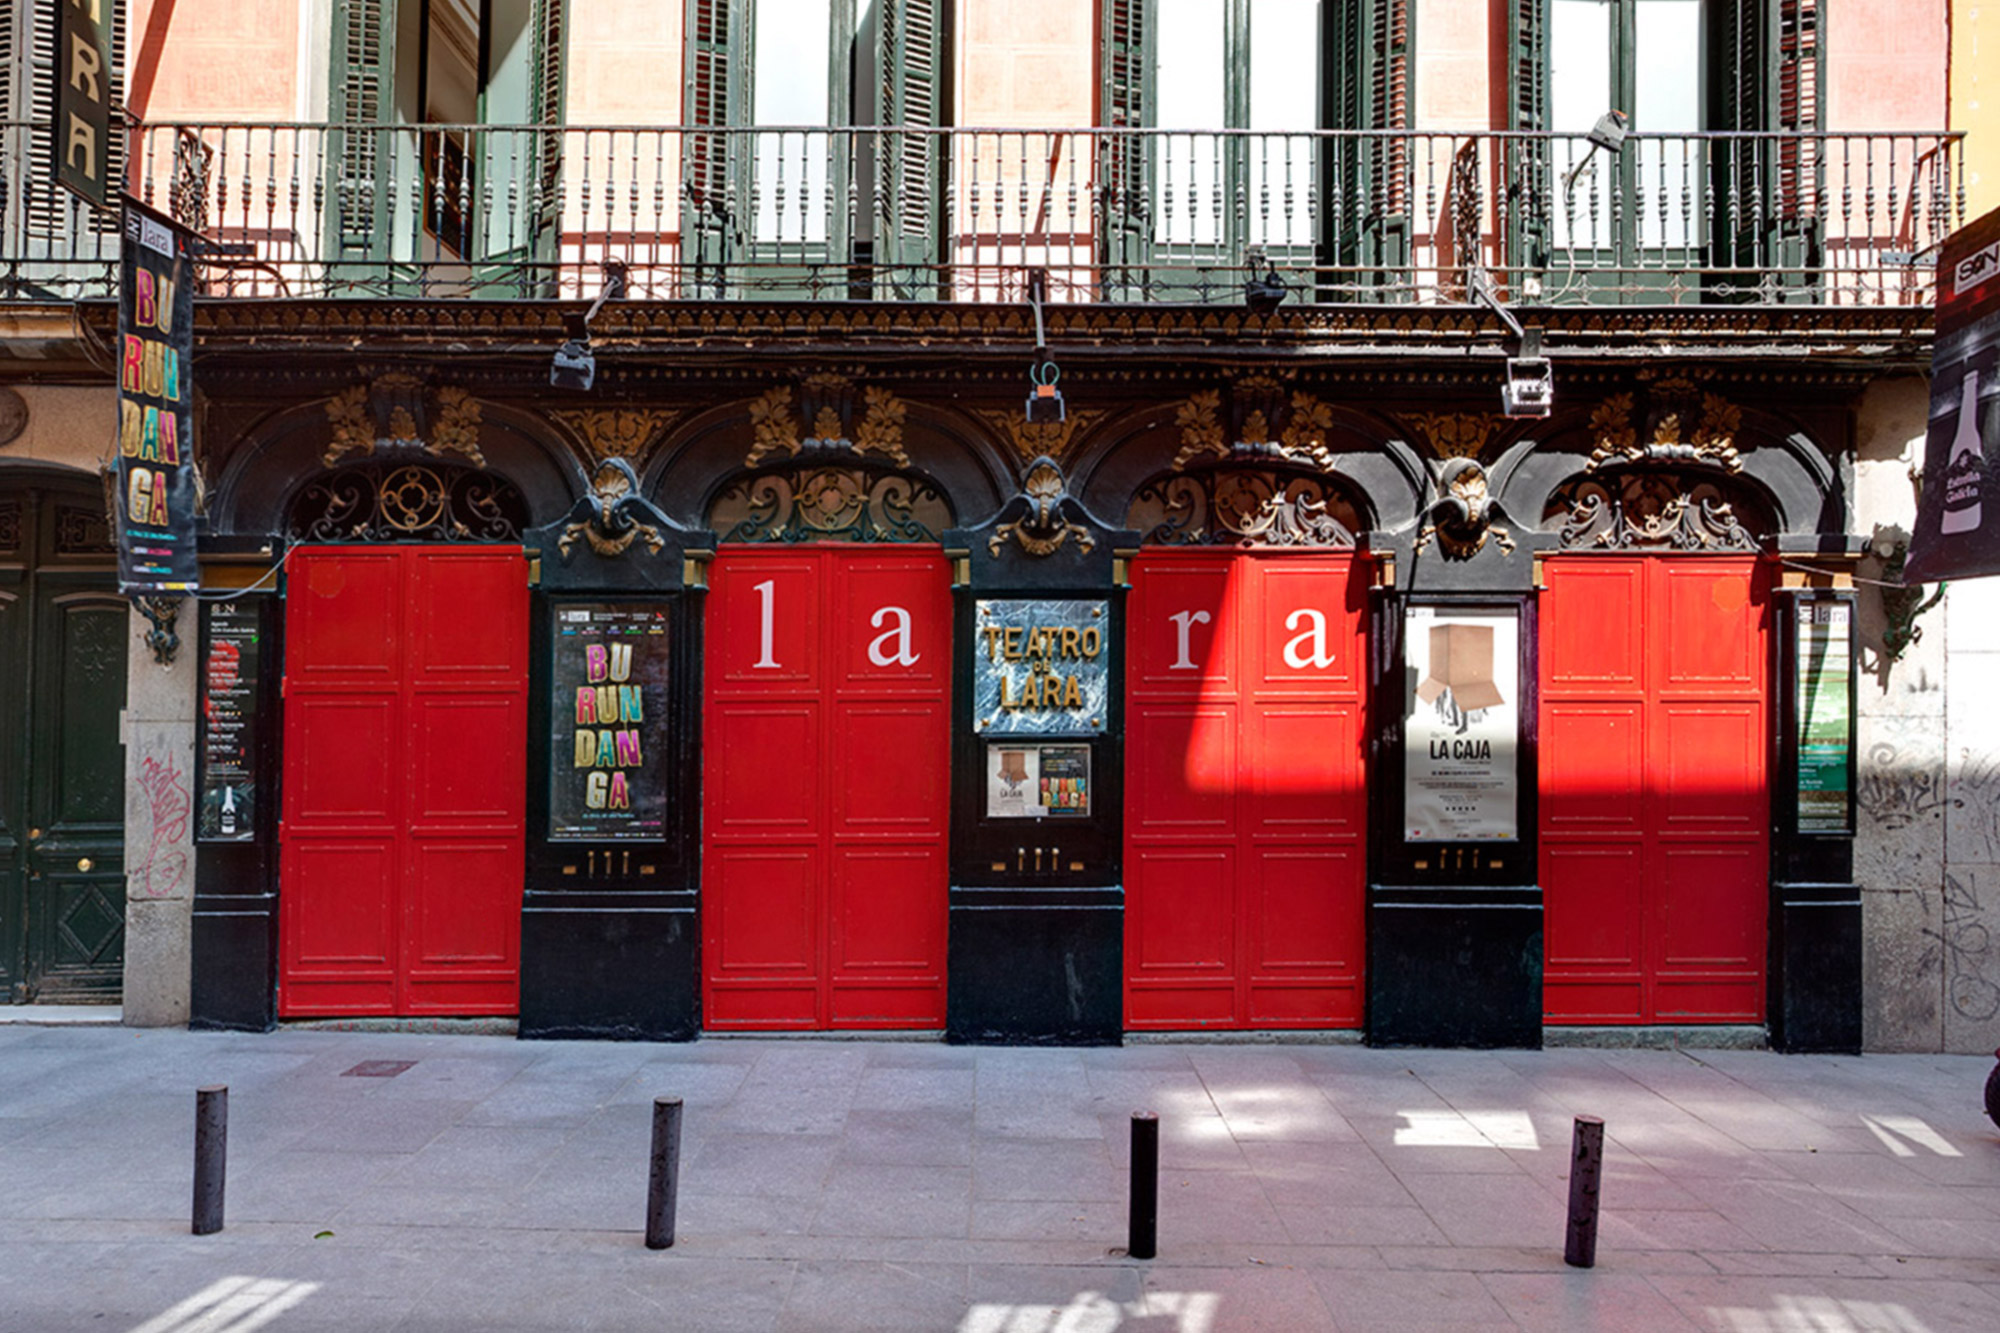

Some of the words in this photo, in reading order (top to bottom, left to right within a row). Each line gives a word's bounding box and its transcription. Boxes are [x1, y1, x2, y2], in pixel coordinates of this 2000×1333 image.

[67, 0, 101, 181] RA
[135, 267, 175, 335] BU
[122, 333, 180, 402] RUN
[120, 398, 180, 466] DAN
[128, 467, 168, 527] GA
[586, 642, 632, 684] BU
[983, 626, 1100, 660] TEATRO
[1033, 660, 1051, 674] DE
[575, 684, 643, 725] RUN
[1000, 675, 1083, 708] LARA
[574, 728, 643, 768] DAN
[1430, 740, 1449, 760] LA
[1453, 739, 1491, 760] CAJA
[586, 771, 630, 809] GA
